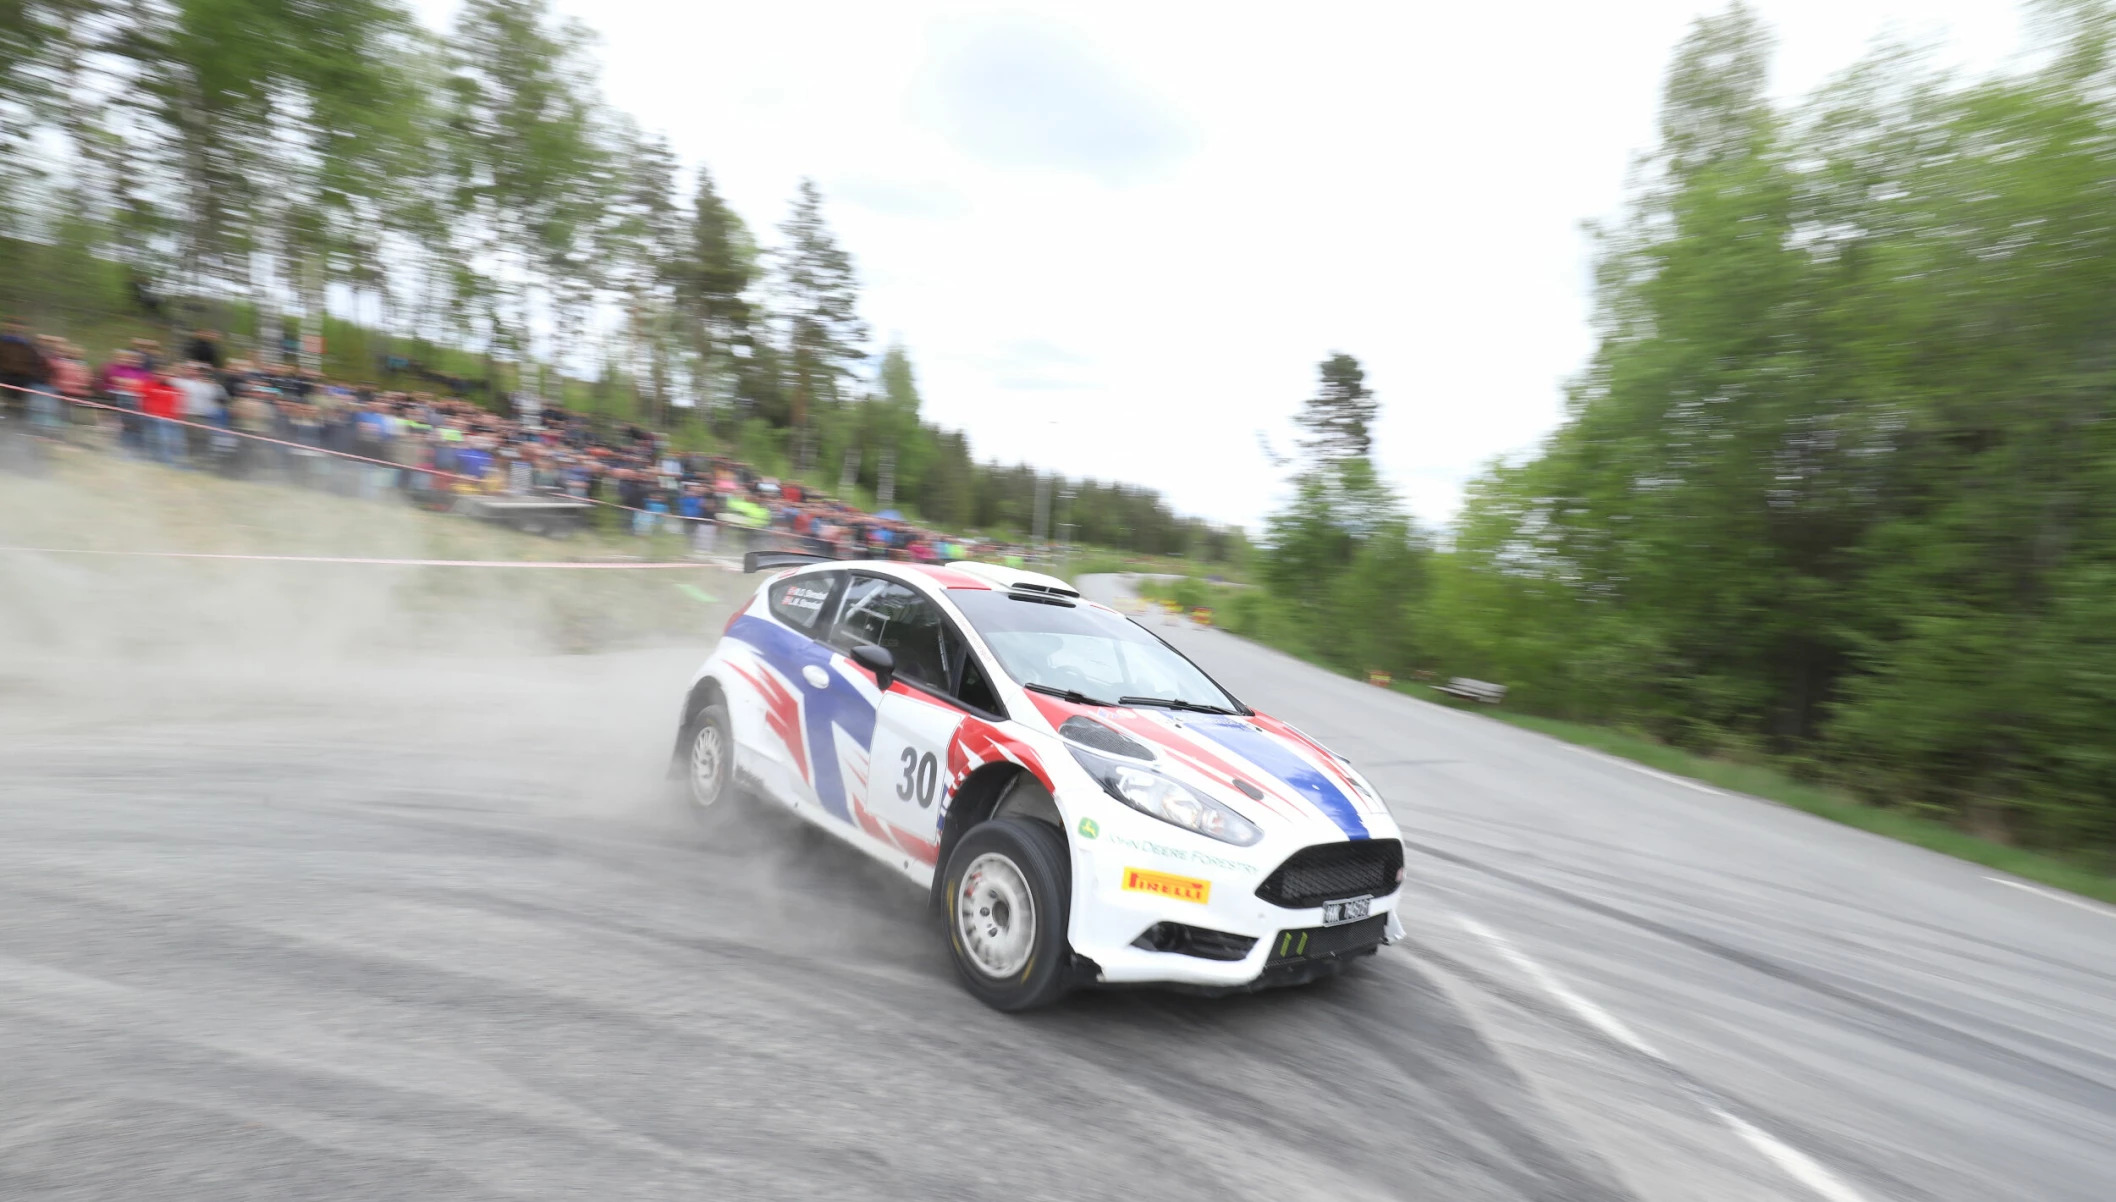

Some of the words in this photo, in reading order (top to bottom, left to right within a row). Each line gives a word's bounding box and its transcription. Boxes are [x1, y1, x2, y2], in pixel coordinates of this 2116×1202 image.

[896, 746, 938, 809] 30
[1106, 833, 1139, 849] OHN
[1129, 872, 1203, 899] PIRELLI
